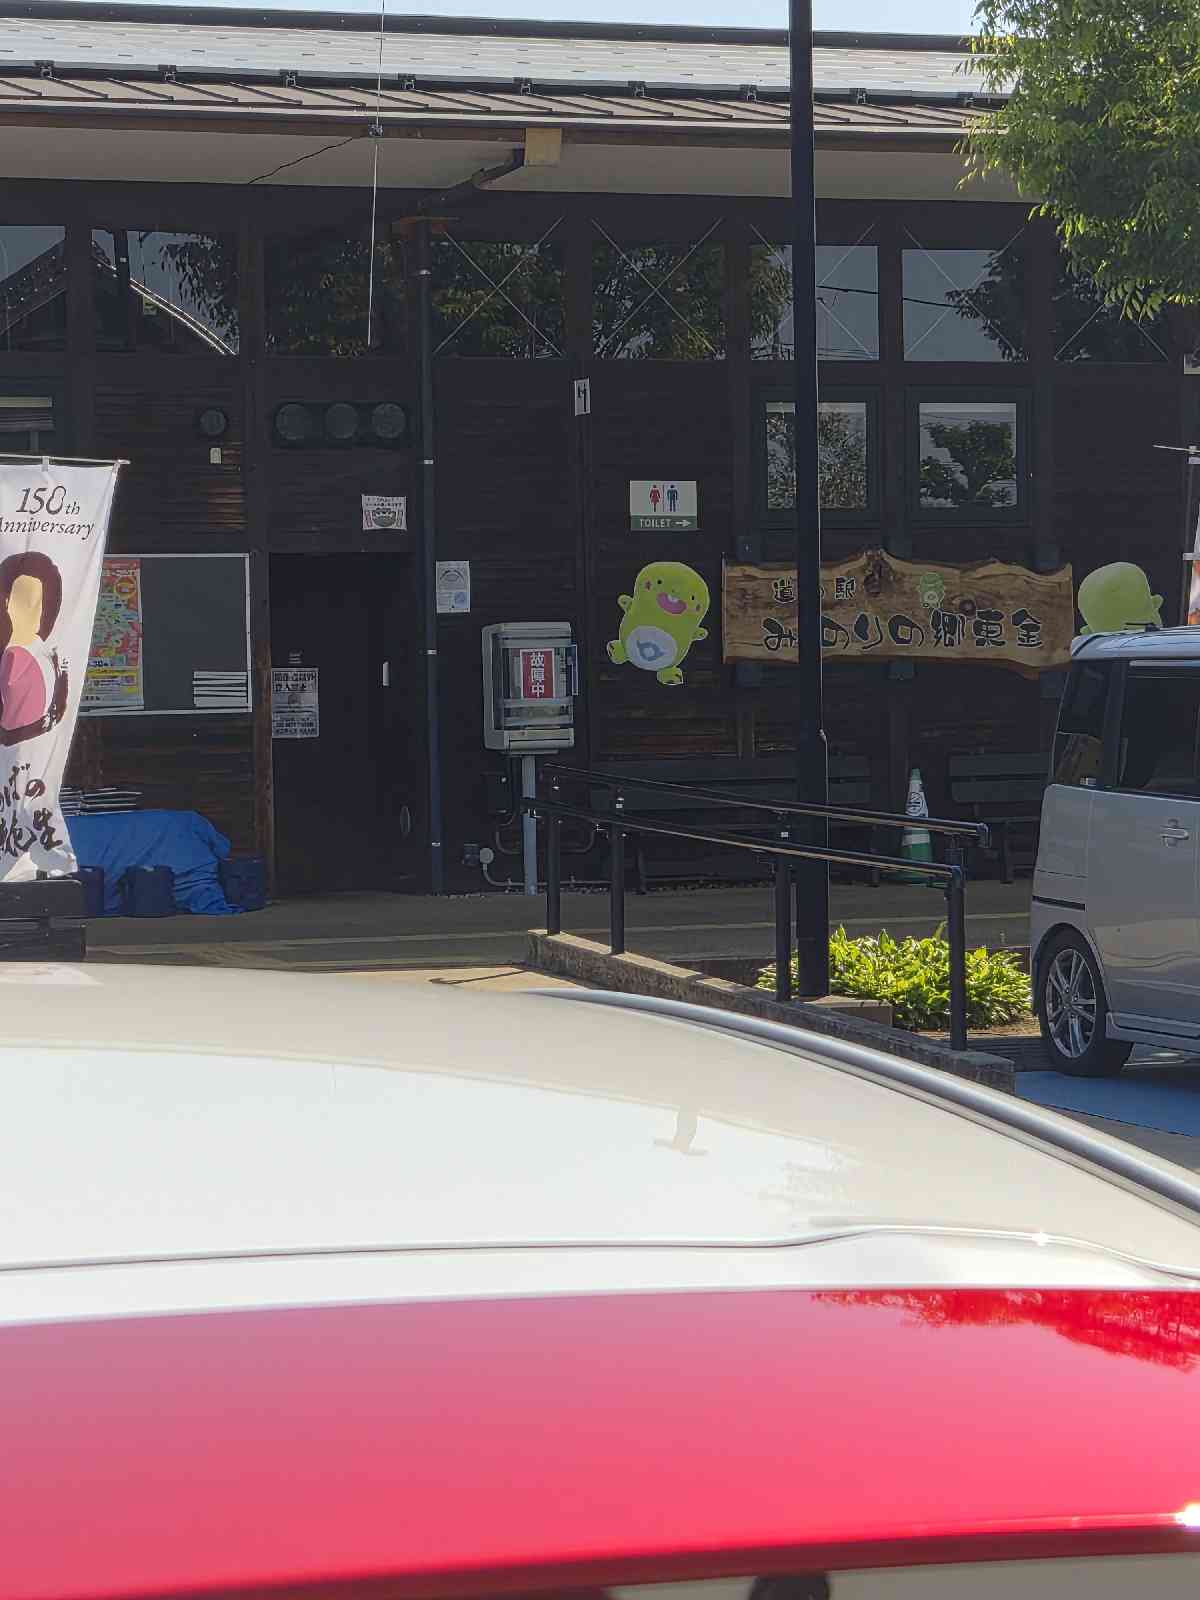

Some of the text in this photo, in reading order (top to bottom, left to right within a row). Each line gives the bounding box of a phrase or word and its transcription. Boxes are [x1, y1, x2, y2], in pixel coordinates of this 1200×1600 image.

[16, 485, 80, 516] 150th
[640, 518, 672, 529] TOILET
[772, 575, 857, 604] 道駅
[530, 651, 545, 697] 故障中
[0, 763, 46, 813] ばの
